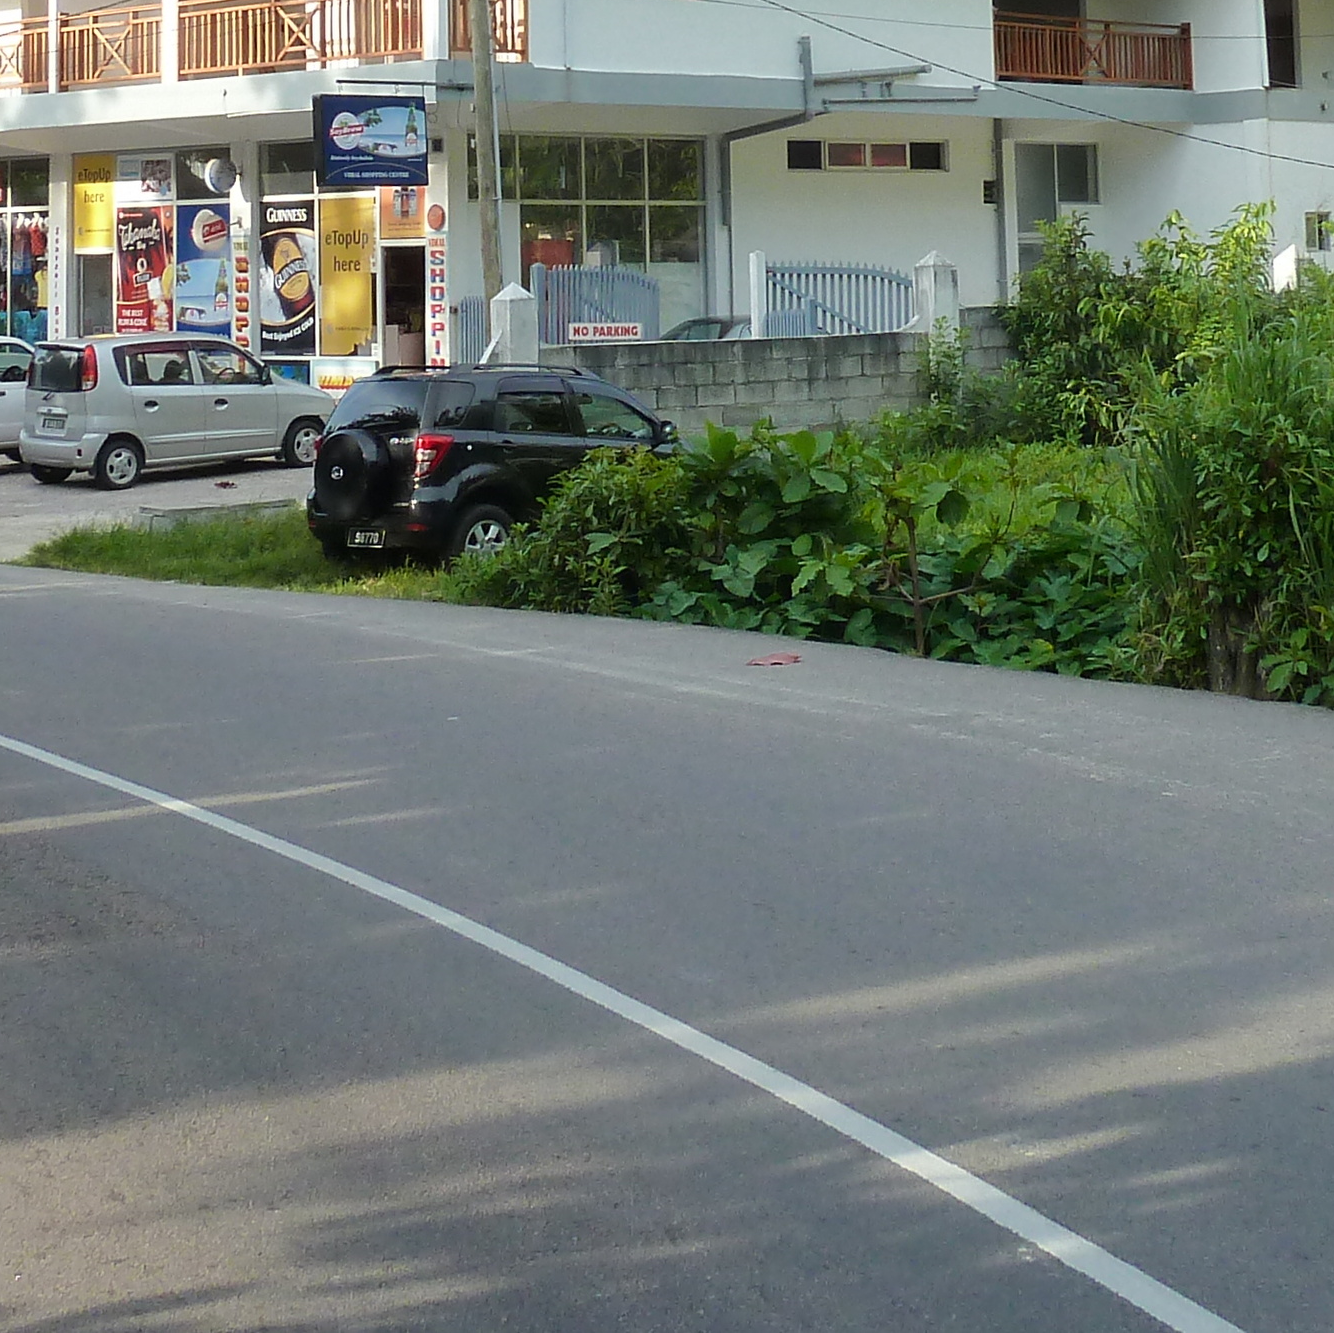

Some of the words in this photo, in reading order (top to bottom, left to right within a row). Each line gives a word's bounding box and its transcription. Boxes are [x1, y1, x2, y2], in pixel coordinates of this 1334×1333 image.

[78, 168, 111, 183] eTopUp
[84, 191, 105, 203] here
[266, 208, 308, 223] GUINNESS
[325, 229, 369, 250] eTopUp
[333, 256, 361, 272] here
[274, 259, 308, 290] GUINNESS
[573, 326, 589, 337] NO
[593, 326, 638, 337] PARKING
